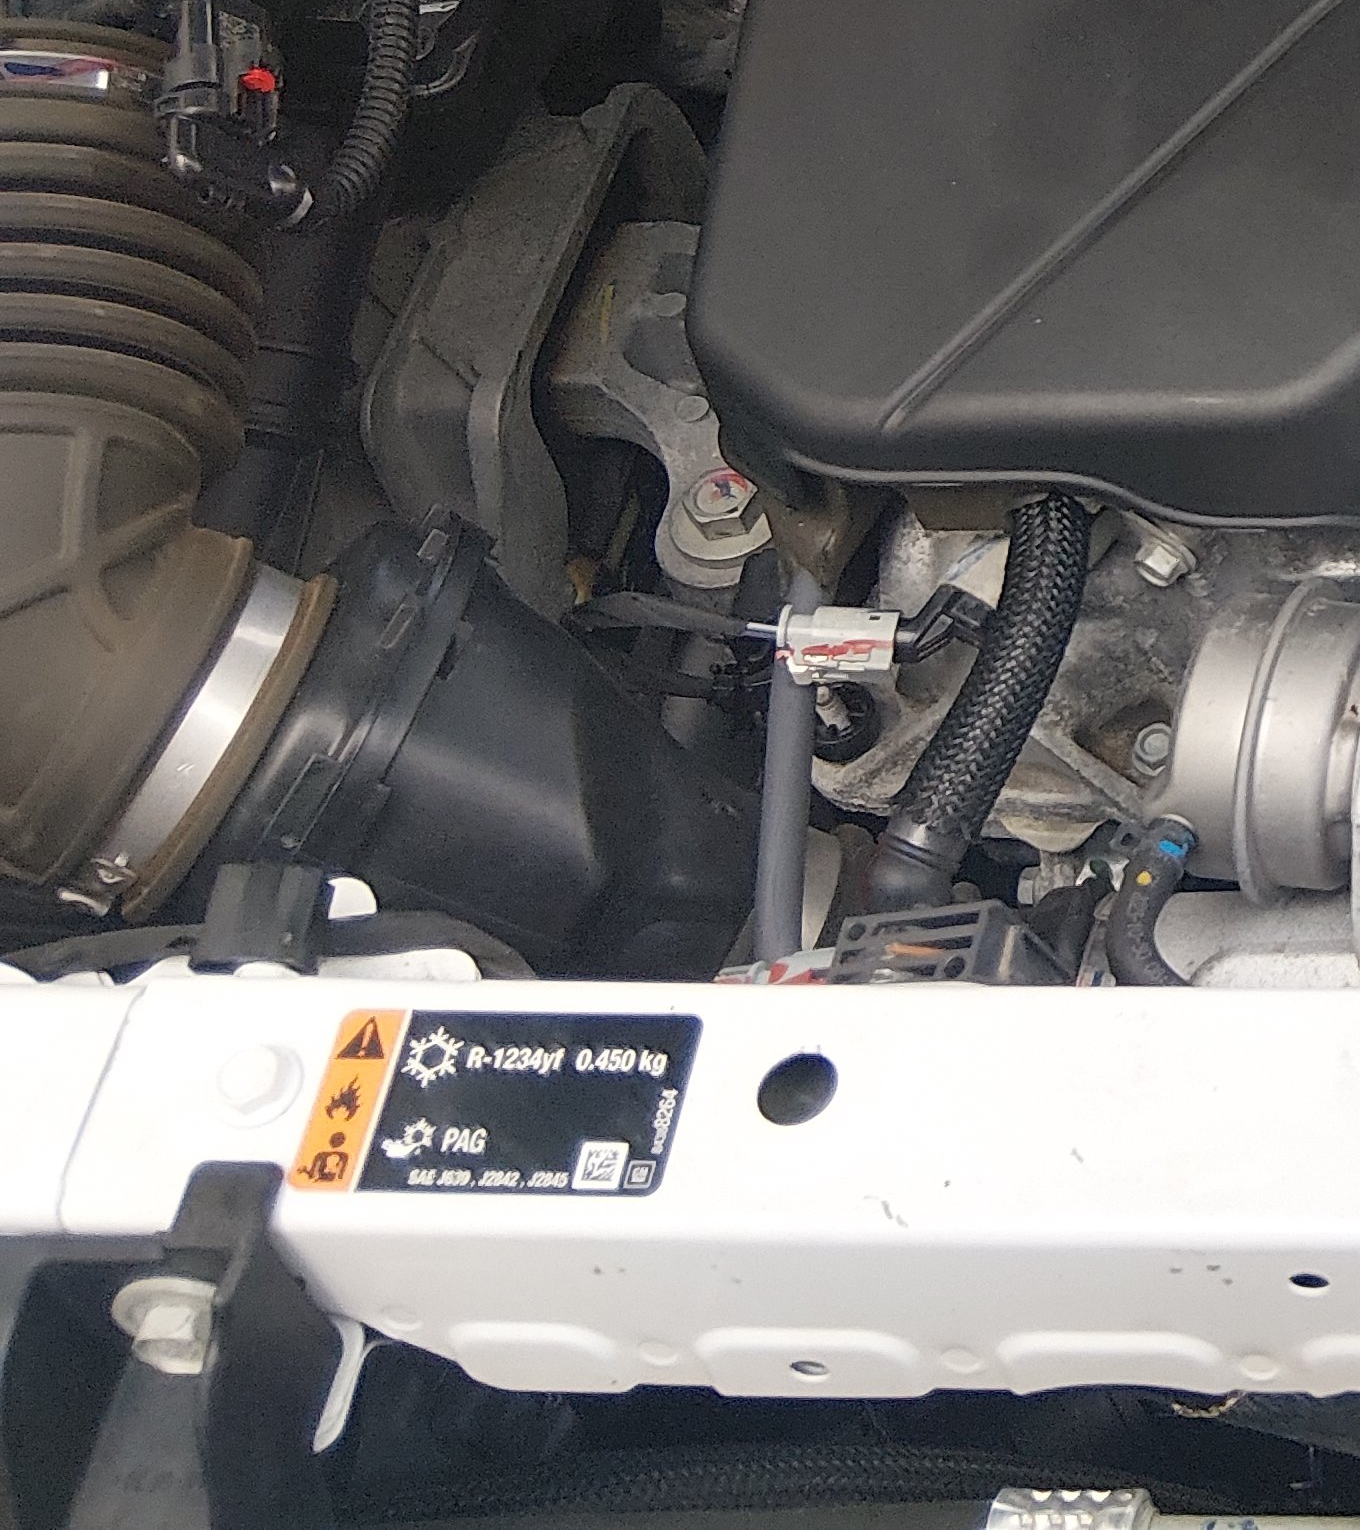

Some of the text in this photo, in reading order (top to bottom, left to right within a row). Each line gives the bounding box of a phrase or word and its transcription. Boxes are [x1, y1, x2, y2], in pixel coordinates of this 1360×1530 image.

[466, 1047, 668, 1077] R-1234yf 0.450 kg
[440, 1127, 488, 1154] PAG
